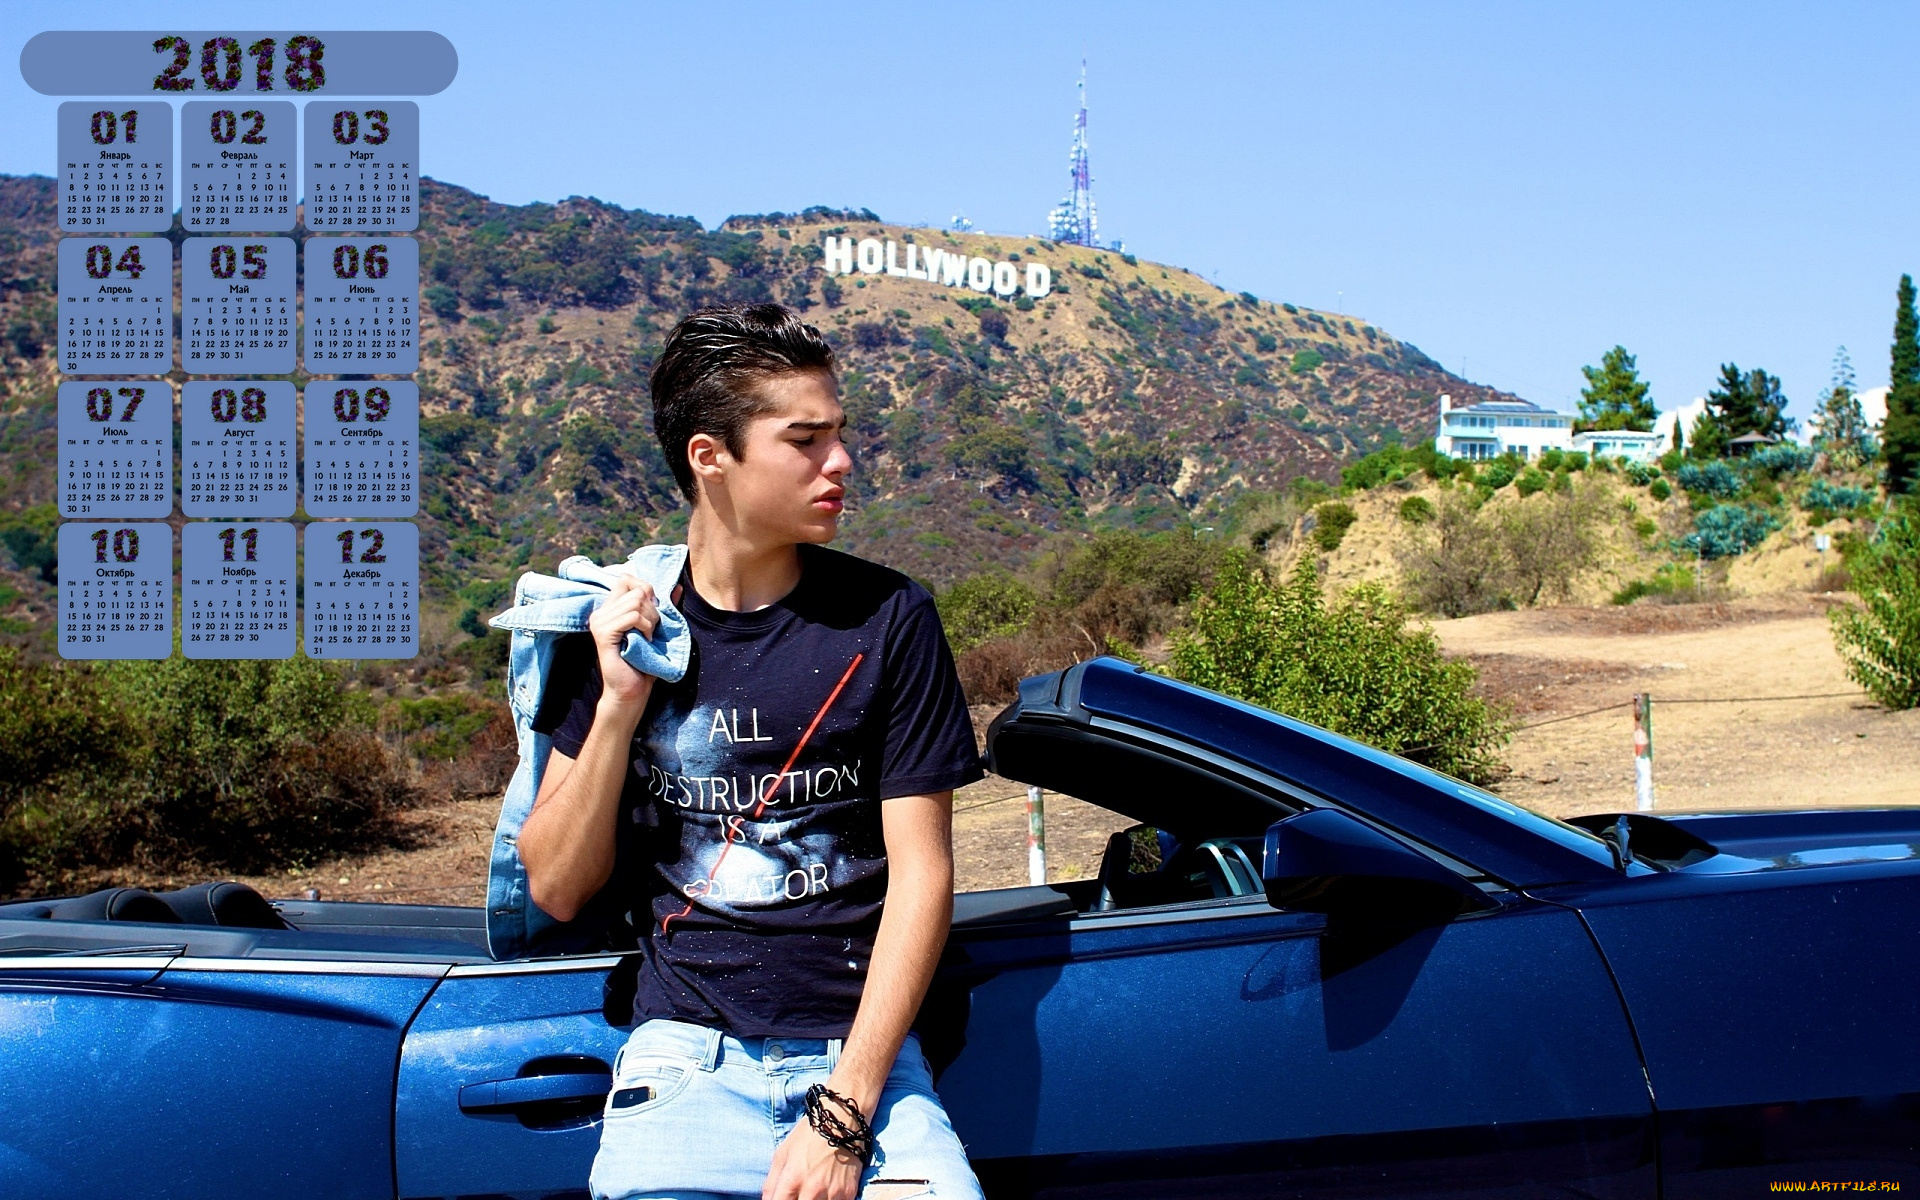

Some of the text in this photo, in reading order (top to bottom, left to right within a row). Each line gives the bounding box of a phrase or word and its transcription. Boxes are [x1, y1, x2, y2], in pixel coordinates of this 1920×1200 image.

[824, 236, 1050, 299] HOLLYWOOD
[709, 707, 773, 743] ALL
[648, 759, 861, 812] DESTRUCTION
[718, 814, 781, 844] IS A
